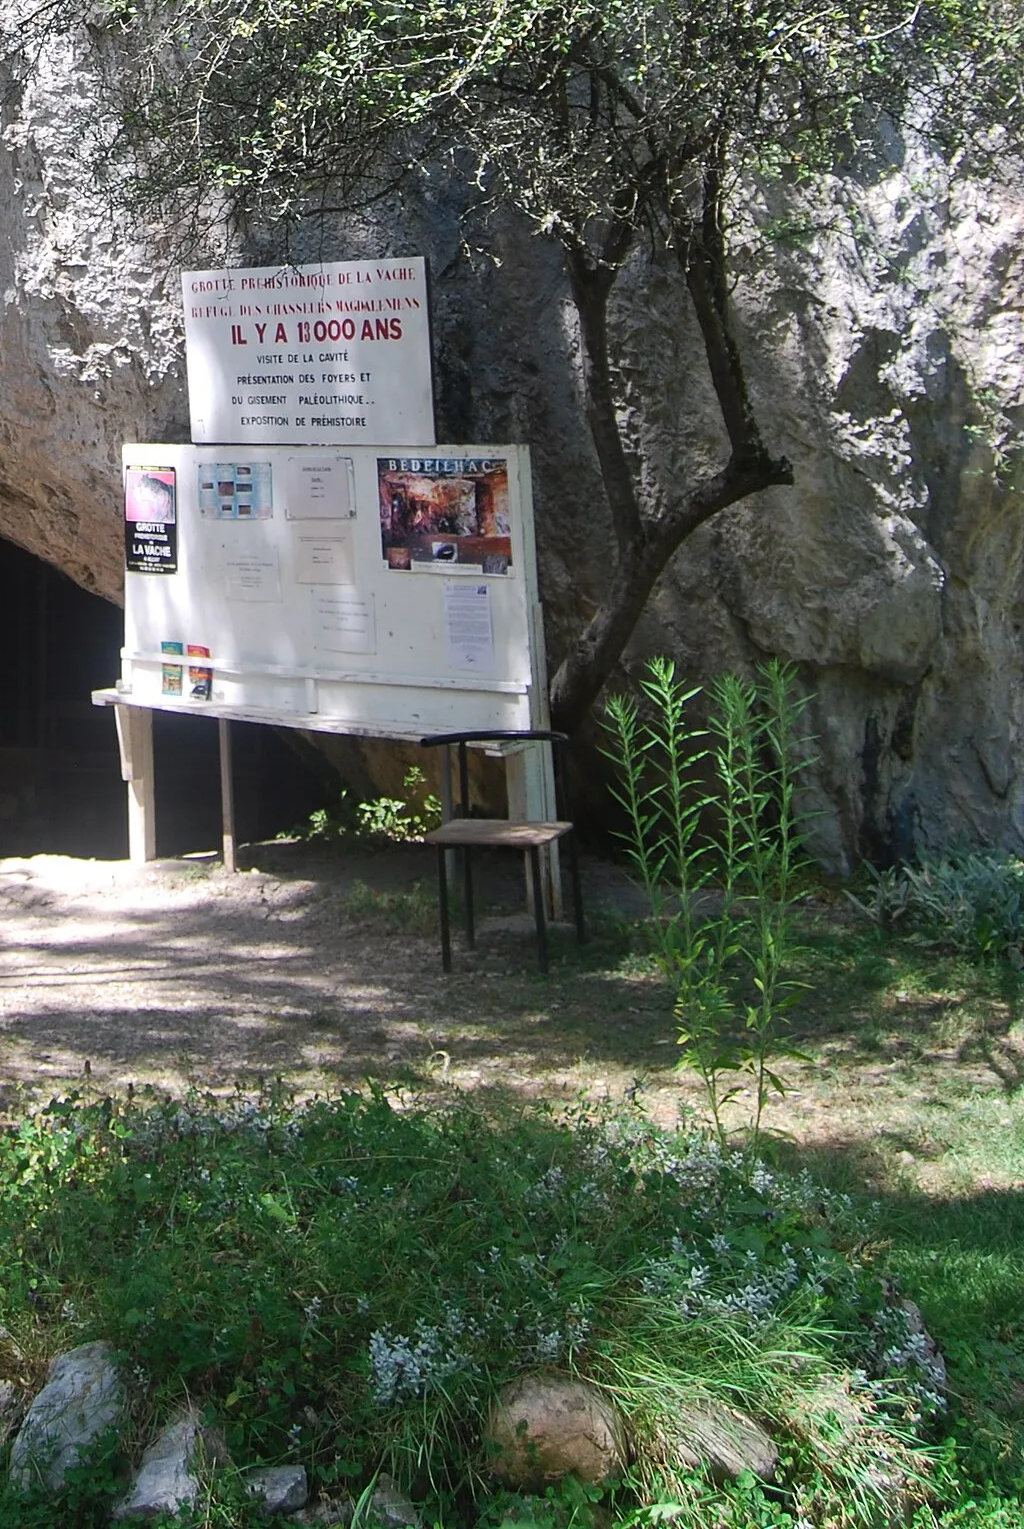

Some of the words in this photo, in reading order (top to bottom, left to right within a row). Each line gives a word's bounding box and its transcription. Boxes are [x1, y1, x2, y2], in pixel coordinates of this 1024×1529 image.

[191, 278, 235, 293] GROTTE
[338, 272, 352, 285] DE
[357, 271, 371, 283] LA
[376, 268, 415, 281] VACHE
[191, 306, 235, 318] REFUGE
[239, 304, 261, 316] DES
[266, 300, 332, 316] CHASSEURS
[231, 325, 247, 345] IL
[255, 323, 267, 343] Y
[275, 322, 287, 343] A
[360, 317, 402, 341] ANS
[256, 354, 283, 364] VISITE
[287, 354, 298, 363] DE
[303, 354, 314, 363] LA
[318, 348, 348, 362] CAVITÉ
[237, 373, 294, 385] PRÉSENTATION
[299, 374, 315, 384] DES
[322, 374, 356, 383] FOYERS
[360, 372, 371, 382] ET
[232, 396, 243, 405] DU
[247, 395, 287, 405] GISEMENT
[240, 416, 289, 426] EXPOSITION
[295, 417, 306, 426] DE
[311, 414, 367, 427] PRÉHISTOIRE
[388, 459, 491, 472] BEDEILHAC
[136, 522, 165, 533] GROTTE
[132, 544, 144, 555] LA
[144, 545, 171, 557] VACHE
